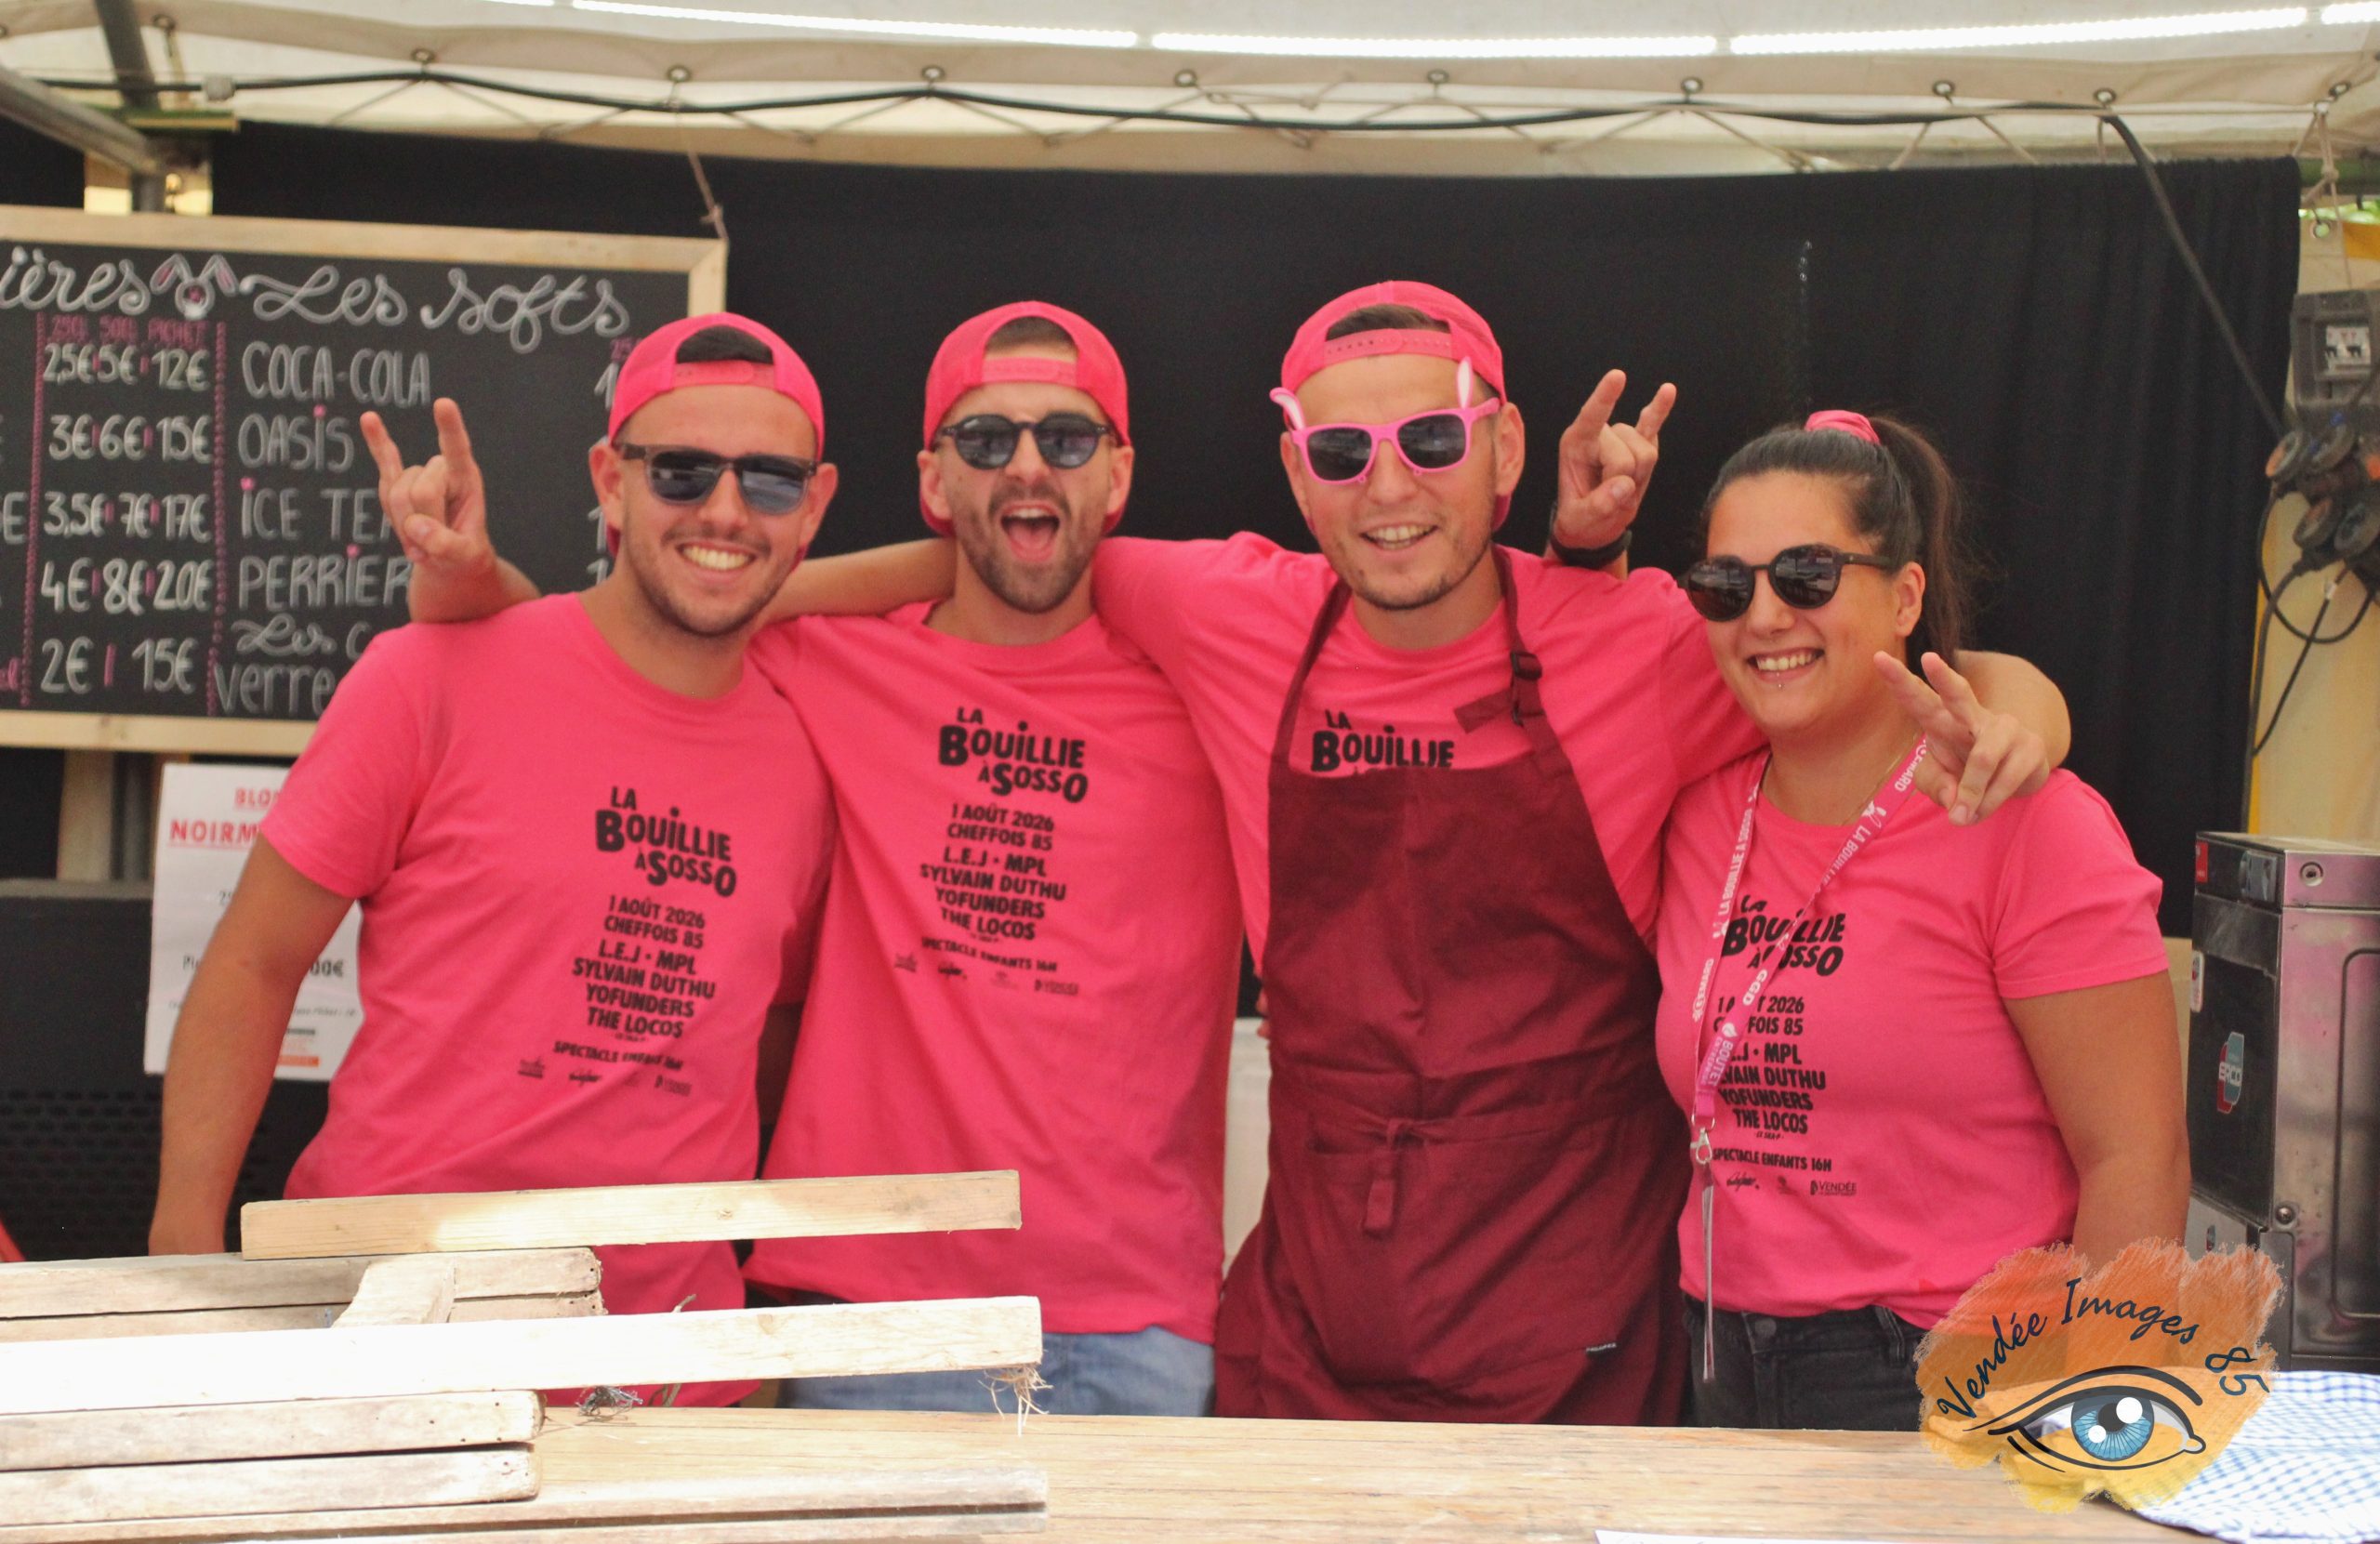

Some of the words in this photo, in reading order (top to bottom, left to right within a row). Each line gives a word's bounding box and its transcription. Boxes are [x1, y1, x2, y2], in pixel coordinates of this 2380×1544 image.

[239, 265, 407, 327] Les
[420, 268, 629, 353] softs
[152, 348, 210, 391] 12€
[242, 340, 431, 408] COCA-COLA
[48, 414, 95, 461] 3€
[99, 414, 148, 461] 6€
[118, 493, 153, 539] 7€
[162, 494, 213, 543] 17€
[320, 487, 392, 544] TE
[41, 558, 93, 613] 4€
[103, 558, 149, 615] 8€
[152, 560, 215, 612] 20€
[40, 636, 94, 694] 2€
[132, 637, 200, 694] 15€
[957, 706, 984, 725] LA
[1324, 708, 1353, 730] LA
[611, 786, 637, 811] LA
[991, 762, 1089, 803] SOSSO
[947, 823, 1026, 847] CHEFFOIS
[1031, 835, 1053, 851] 85
[1012, 811, 1054, 833] 2026
[647, 850, 737, 897] SOSSO
[1005, 853, 1048, 878] MPL
[919, 863, 994, 891] SYLVAIN
[999, 875, 1067, 901] DUTHU
[665, 906, 706, 929] 2026
[935, 887, 1046, 919] YOFUNDERS
[1739, 894, 1768, 914] LA
[604, 916, 679, 945] CHEFFOIS
[682, 931, 704, 950] 85
[941, 907, 972, 929] THE
[977, 916, 1037, 941] LOCOS
[572, 957, 645, 988] SYLVAIN
[650, 972, 716, 999] DUTHU
[655, 950, 697, 975] MPL
[585, 983, 695, 1018] YOFUNDERS
[1766, 996, 1805, 1014] 2026
[587, 1006, 622, 1030] THE
[624, 1014, 684, 1038] LOCOS
[1783, 1018, 1804, 1036] 85
[552, 1040, 618, 1063] SPECTACLE
[1764, 1042, 1803, 1065] MPL
[1763, 1066, 1827, 1090] DUTHU
[1732, 1109, 1760, 1129] THE
[1763, 1112, 1808, 1135] LOCOS
[1761, 1152, 1808, 1170] ENFANTS
[1811, 1157, 1832, 1172] 16H
